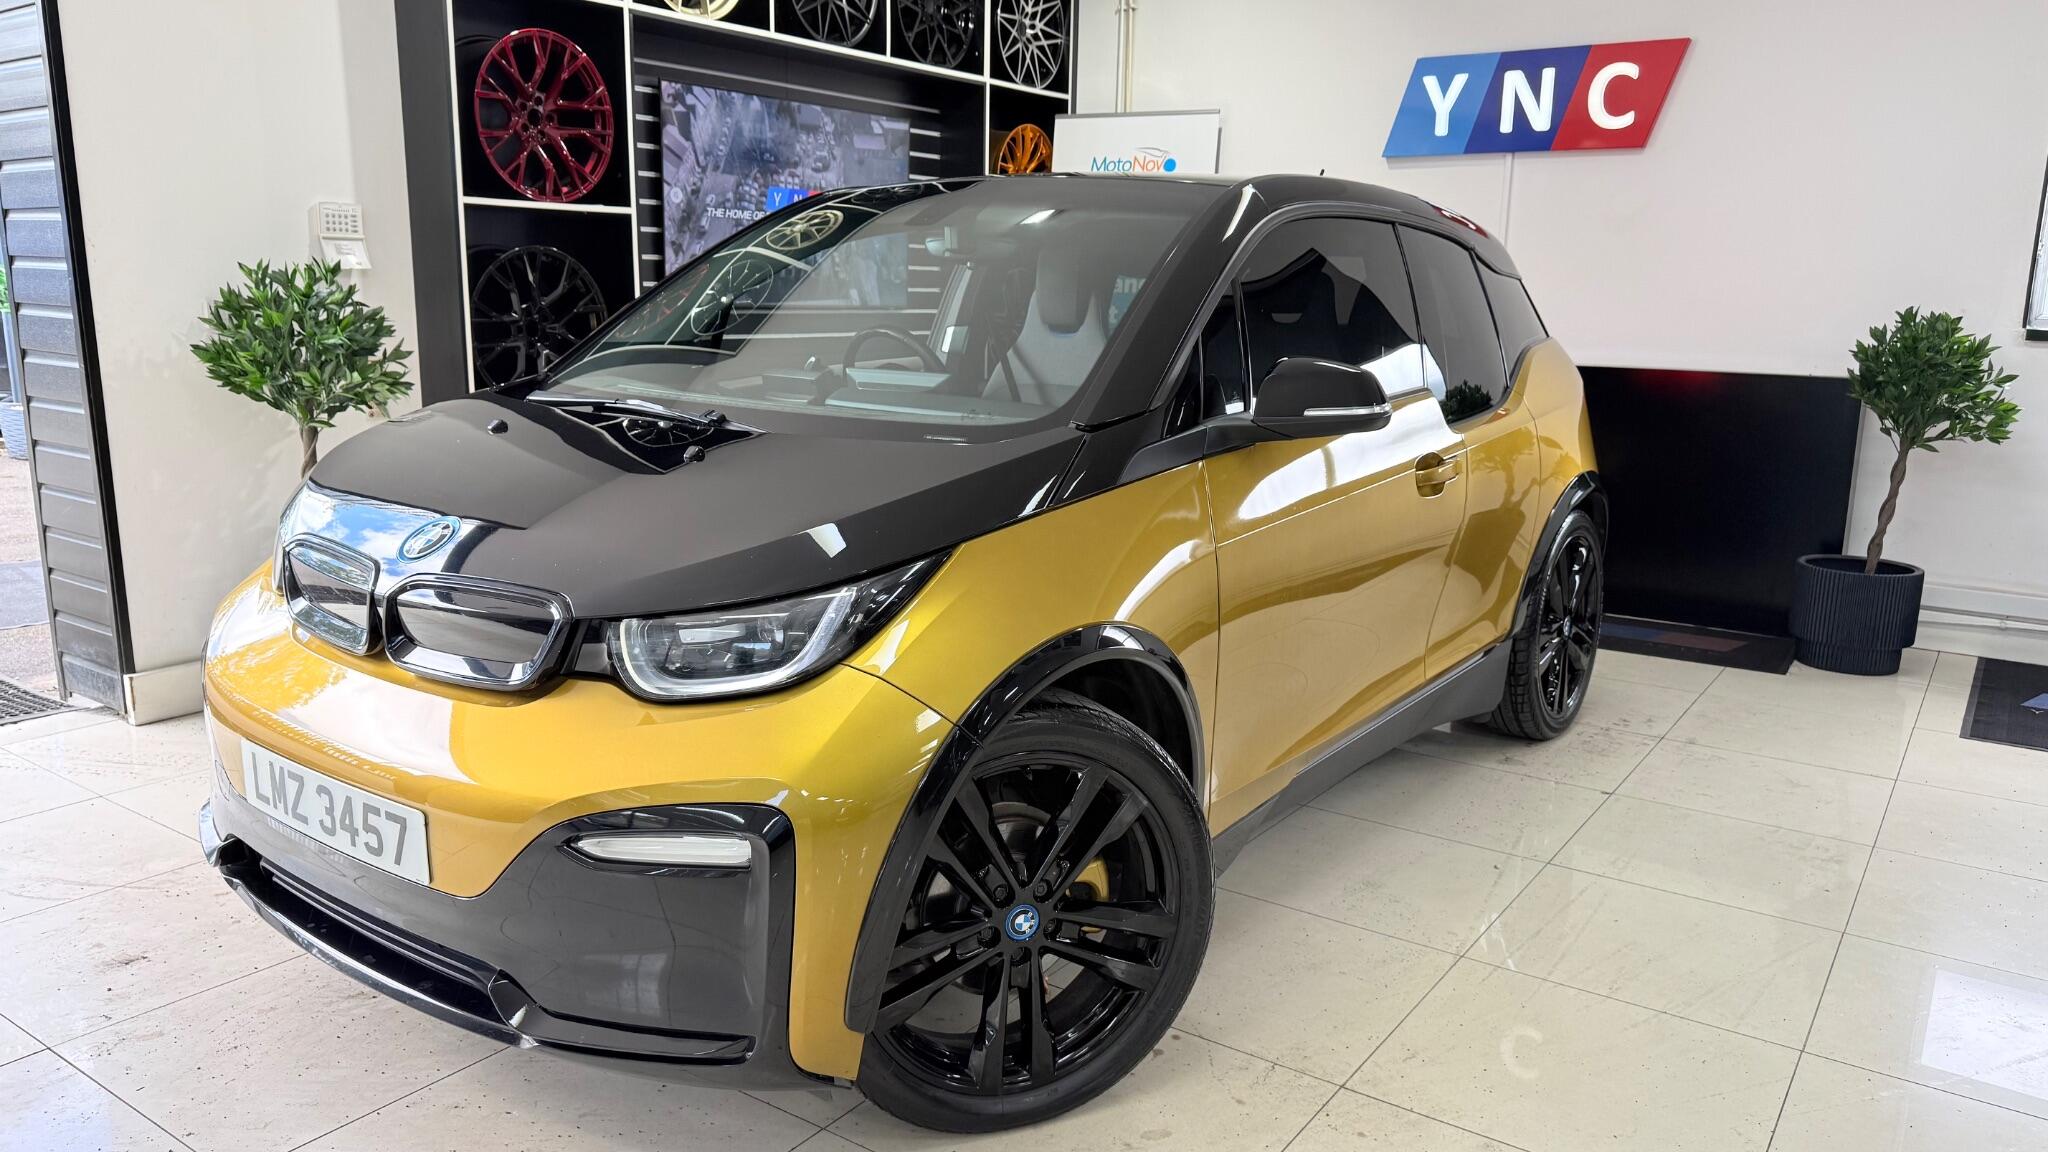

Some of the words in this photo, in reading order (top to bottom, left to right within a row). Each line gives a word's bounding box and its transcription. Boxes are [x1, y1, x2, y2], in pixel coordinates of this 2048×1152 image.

[1422, 61, 1640, 137] YNC
[707, 207, 725, 218] THE
[725, 209, 752, 219] HOME
[251, 751, 309, 826] LMZ
[315, 784, 408, 867] 3457
